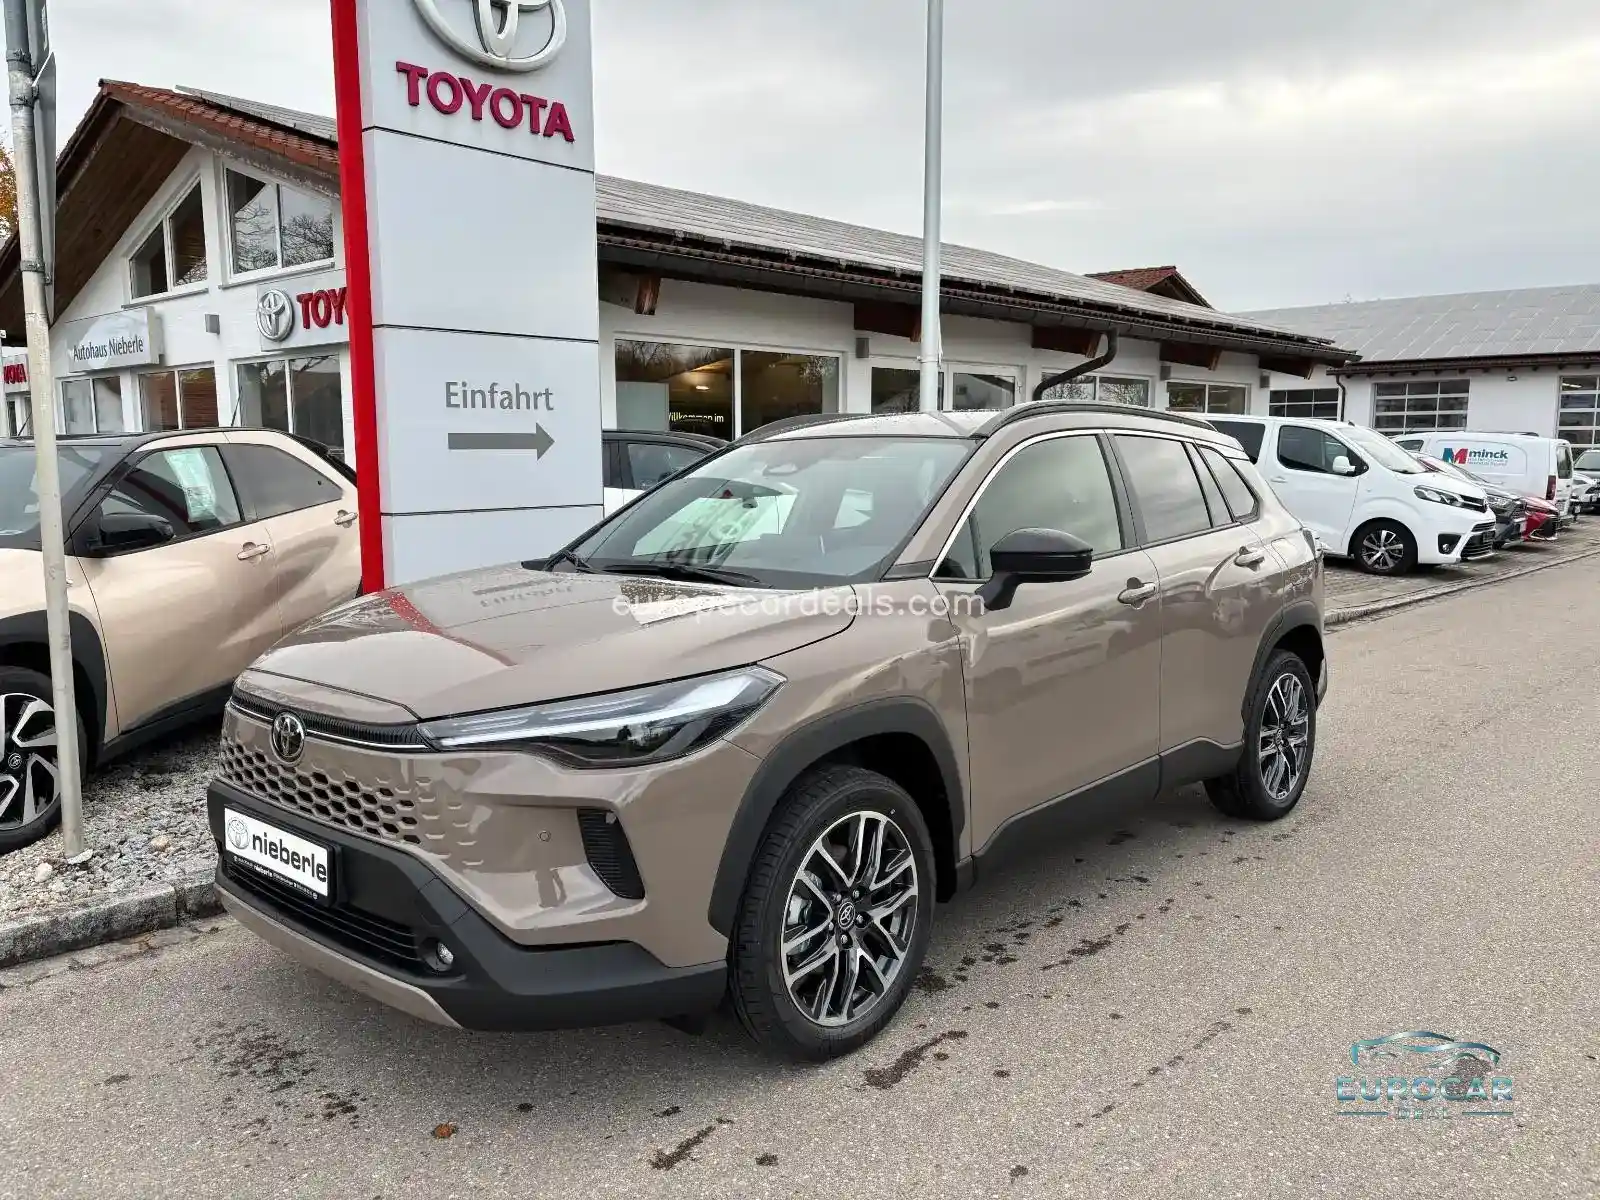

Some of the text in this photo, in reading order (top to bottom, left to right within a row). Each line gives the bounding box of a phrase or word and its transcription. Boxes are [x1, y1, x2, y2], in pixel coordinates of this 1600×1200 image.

[396, 61, 575, 142] TOYOTA
[296, 287, 348, 329] TOY
[73, 334, 144, 361] Autohaus Nieberle
[445, 381, 554, 411] Einfahrt
[1468, 449, 1509, 459] minck
[252, 832, 327, 883] nieberle
